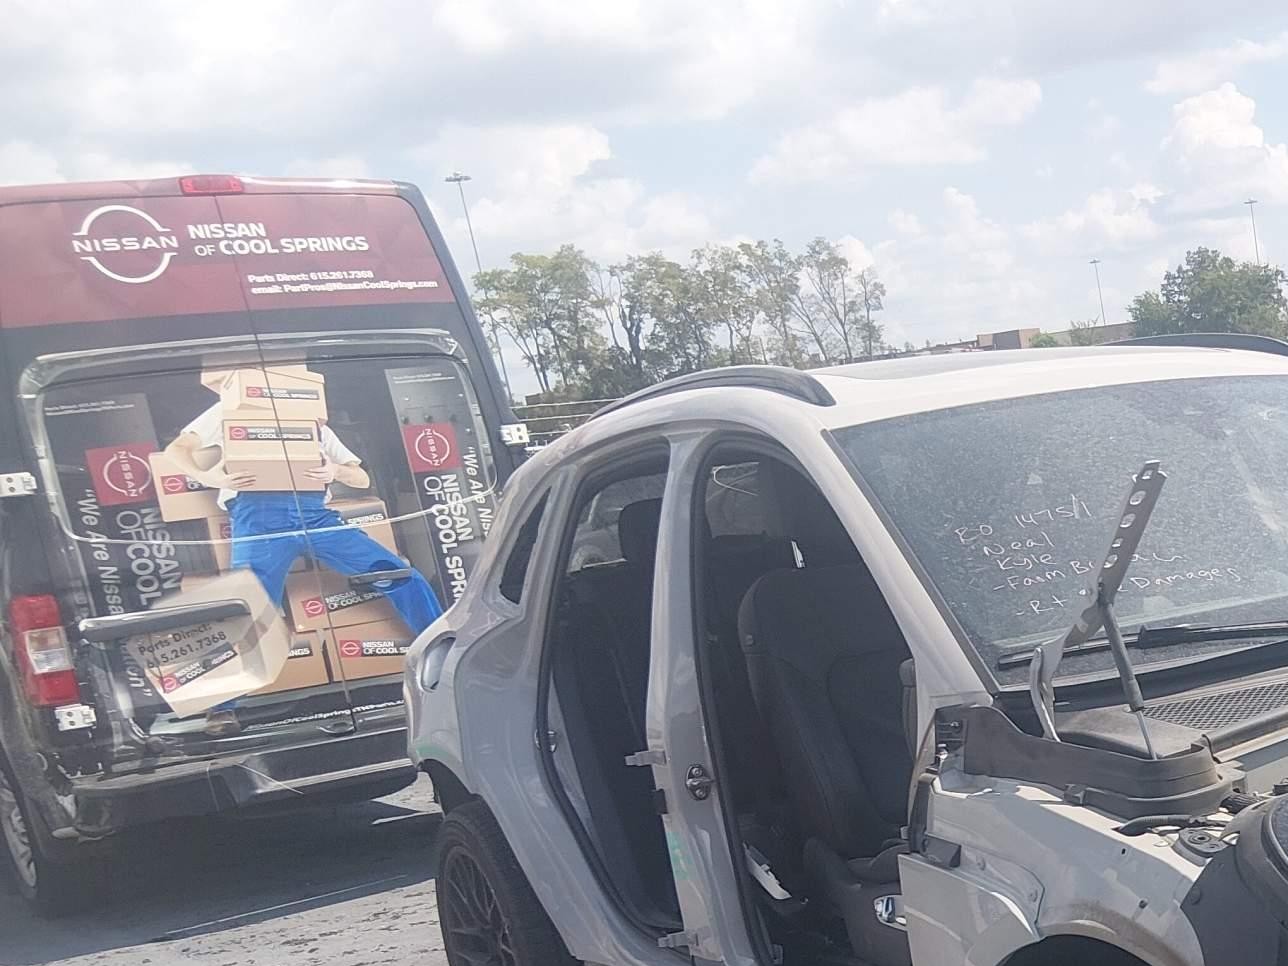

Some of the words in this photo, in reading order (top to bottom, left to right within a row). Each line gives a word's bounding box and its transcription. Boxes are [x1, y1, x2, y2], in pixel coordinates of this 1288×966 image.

[72, 236, 179, 253] NISSAN
[187, 222, 266, 239] NISSAN
[194, 244, 215, 257] OF
[219, 239, 279, 255] COOL
[280, 236, 369, 253] SPRINGS
[247, 274, 275, 283] Parts
[276, 272, 308, 281] Direct:
[426, 428, 440, 467] NISSAN
[117, 450, 138, 497] NISSAN
[424, 476, 445, 502] OF
[441, 473, 474, 544] NISSAN
[116, 511, 147, 543] OF
[433, 503, 459, 554] COOL
[140, 507, 181, 590] NISSAN
[983, 531, 1055, 557] Neal
[126, 542, 162, 606] COOL
[996, 553, 1057, 571] Kyle
[98, 566, 125, 615] Nissa
[138, 639, 171, 656] Parts
[147, 631, 227, 669] 65.261.7368
[363, 648, 377, 656] OF
[376, 648, 399, 656] COOL
